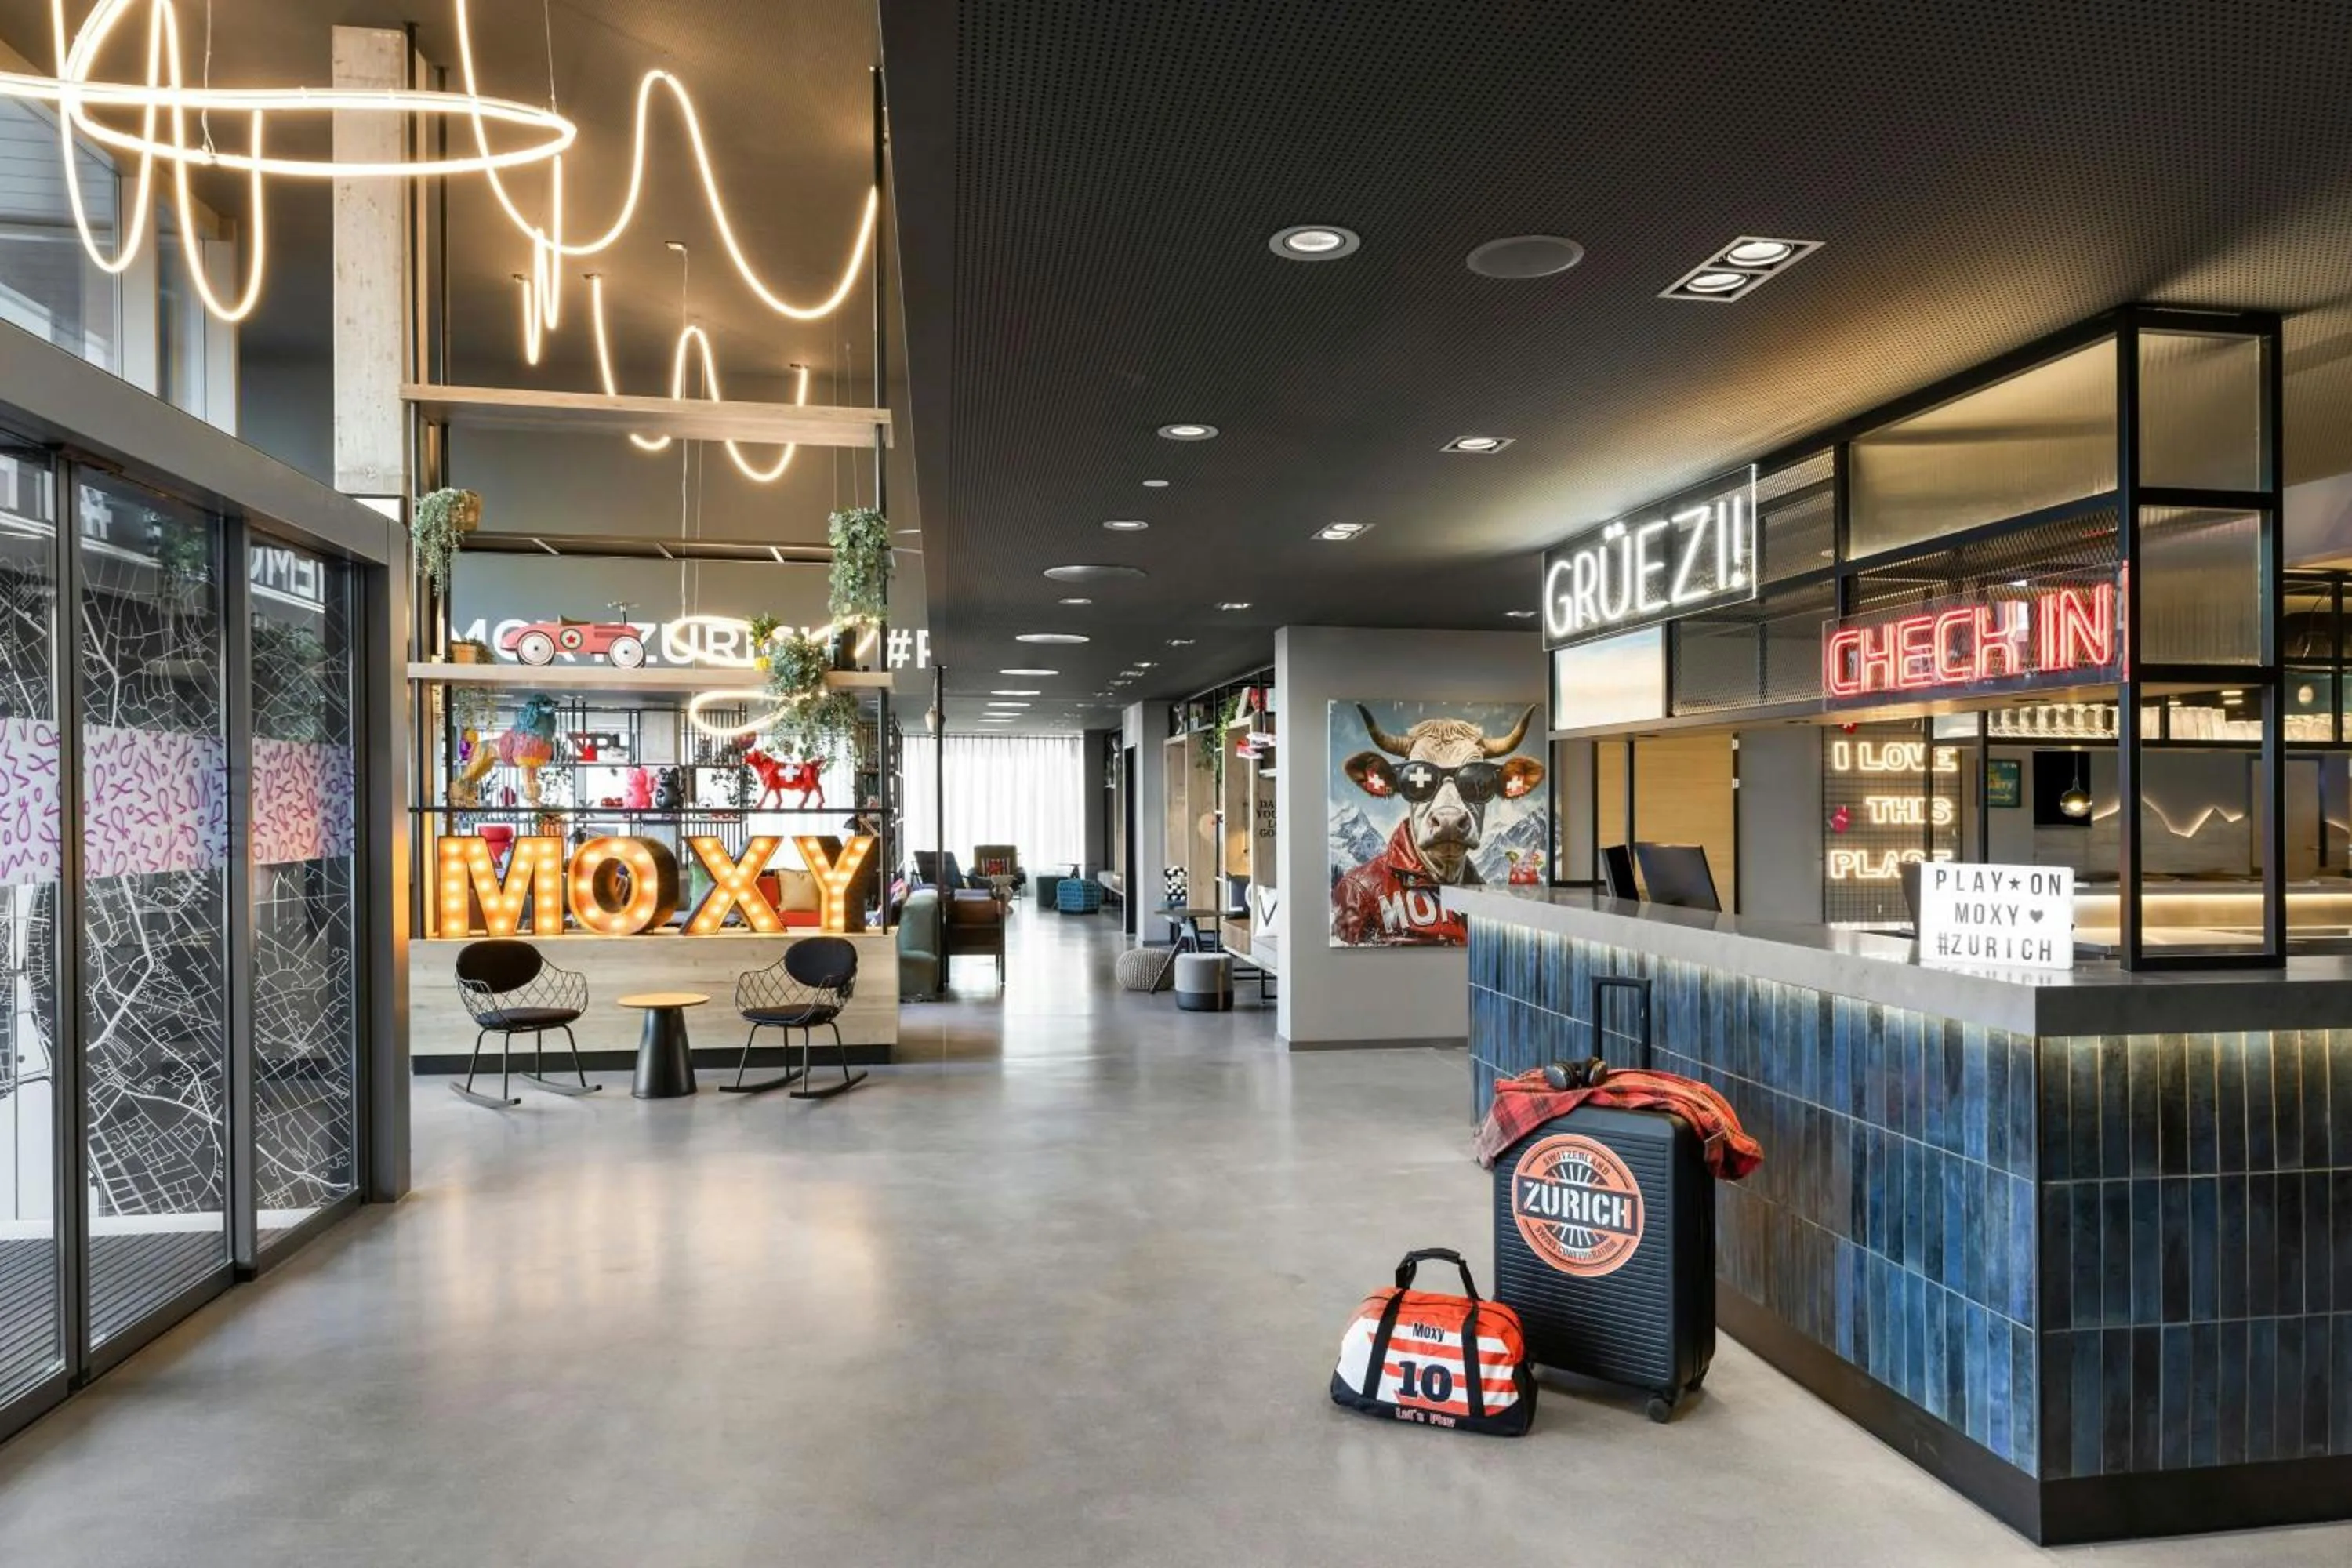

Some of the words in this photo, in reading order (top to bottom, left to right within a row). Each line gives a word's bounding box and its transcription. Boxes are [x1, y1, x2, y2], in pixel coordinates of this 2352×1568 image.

[1544, 495, 1747, 637] GRÜEZI!
[1828, 602, 2020, 696] CHECK
[2039, 583, 2114, 672] IN
[1834, 741, 1849, 771] I
[1858, 742, 1958, 772] LOVE
[1866, 796, 1954, 825] THIS
[437, 835, 876, 937] MOXY
[1936, 869, 2003, 892] PLAY
[2031, 873, 2061, 896] ON
[1955, 902, 2019, 926] MOXY
[1937, 932, 2052, 961] #ZURICH
[1543, 1150, 1610, 1176] SWITZERLAND
[1412, 1323, 1445, 1342] Moxy
[1398, 1360, 1452, 1402] 10
